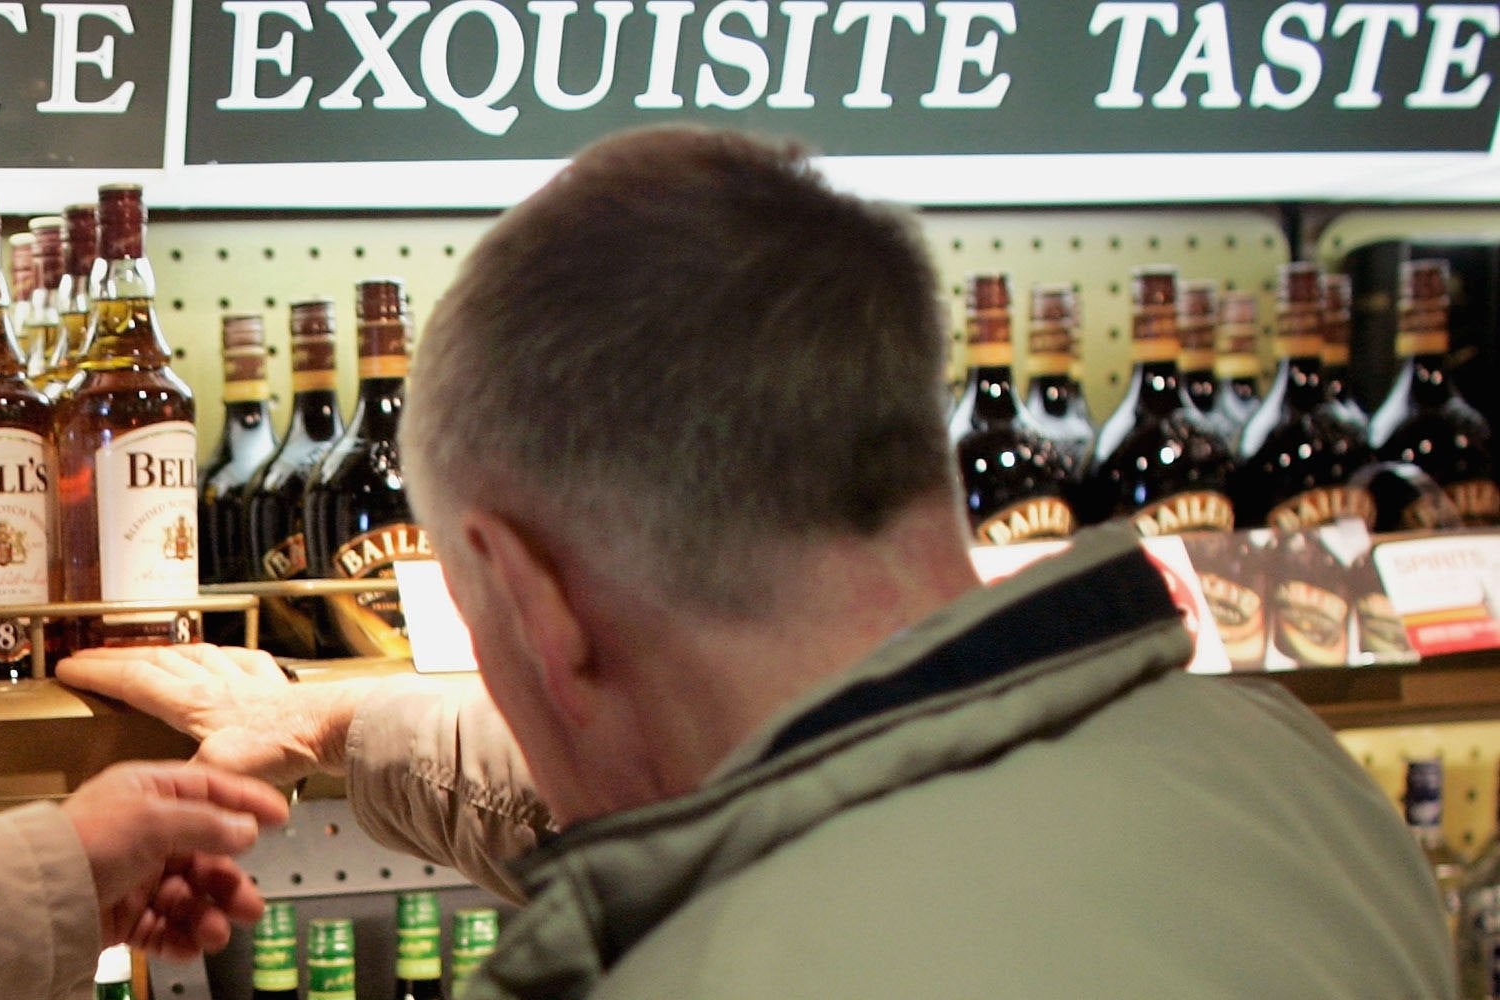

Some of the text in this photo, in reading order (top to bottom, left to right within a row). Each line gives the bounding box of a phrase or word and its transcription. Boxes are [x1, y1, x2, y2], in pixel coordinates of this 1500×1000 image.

[215, 0, 1500, 136] EXQUISITE TASTE
[341, 529, 432, 575] BAILE
